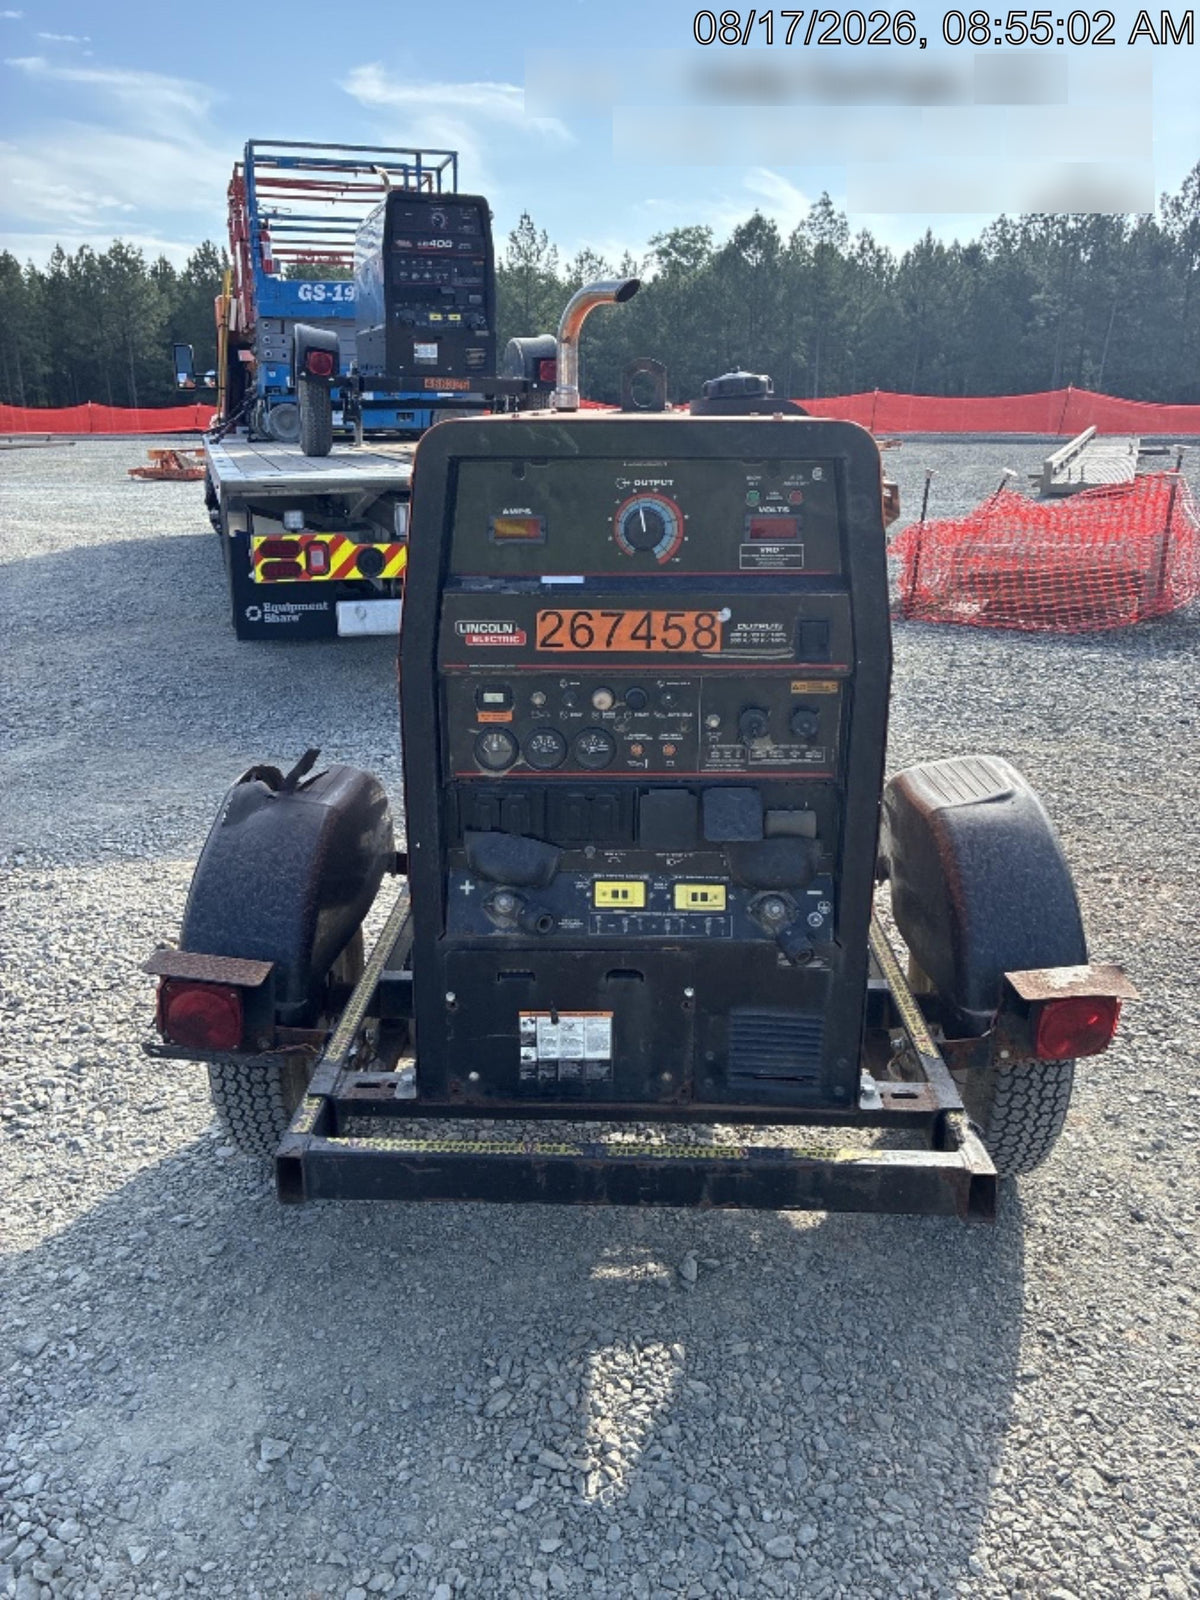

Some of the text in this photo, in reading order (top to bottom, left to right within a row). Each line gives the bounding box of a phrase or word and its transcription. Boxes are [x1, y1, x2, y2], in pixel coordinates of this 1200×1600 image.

[263, 602, 329, 614] Equipment
[263, 612, 301, 623] Share
[459, 623, 513, 634] LINCOLN
[540, 611, 717, 649] 267458
[472, 635, 521, 643] ELECTRIC
